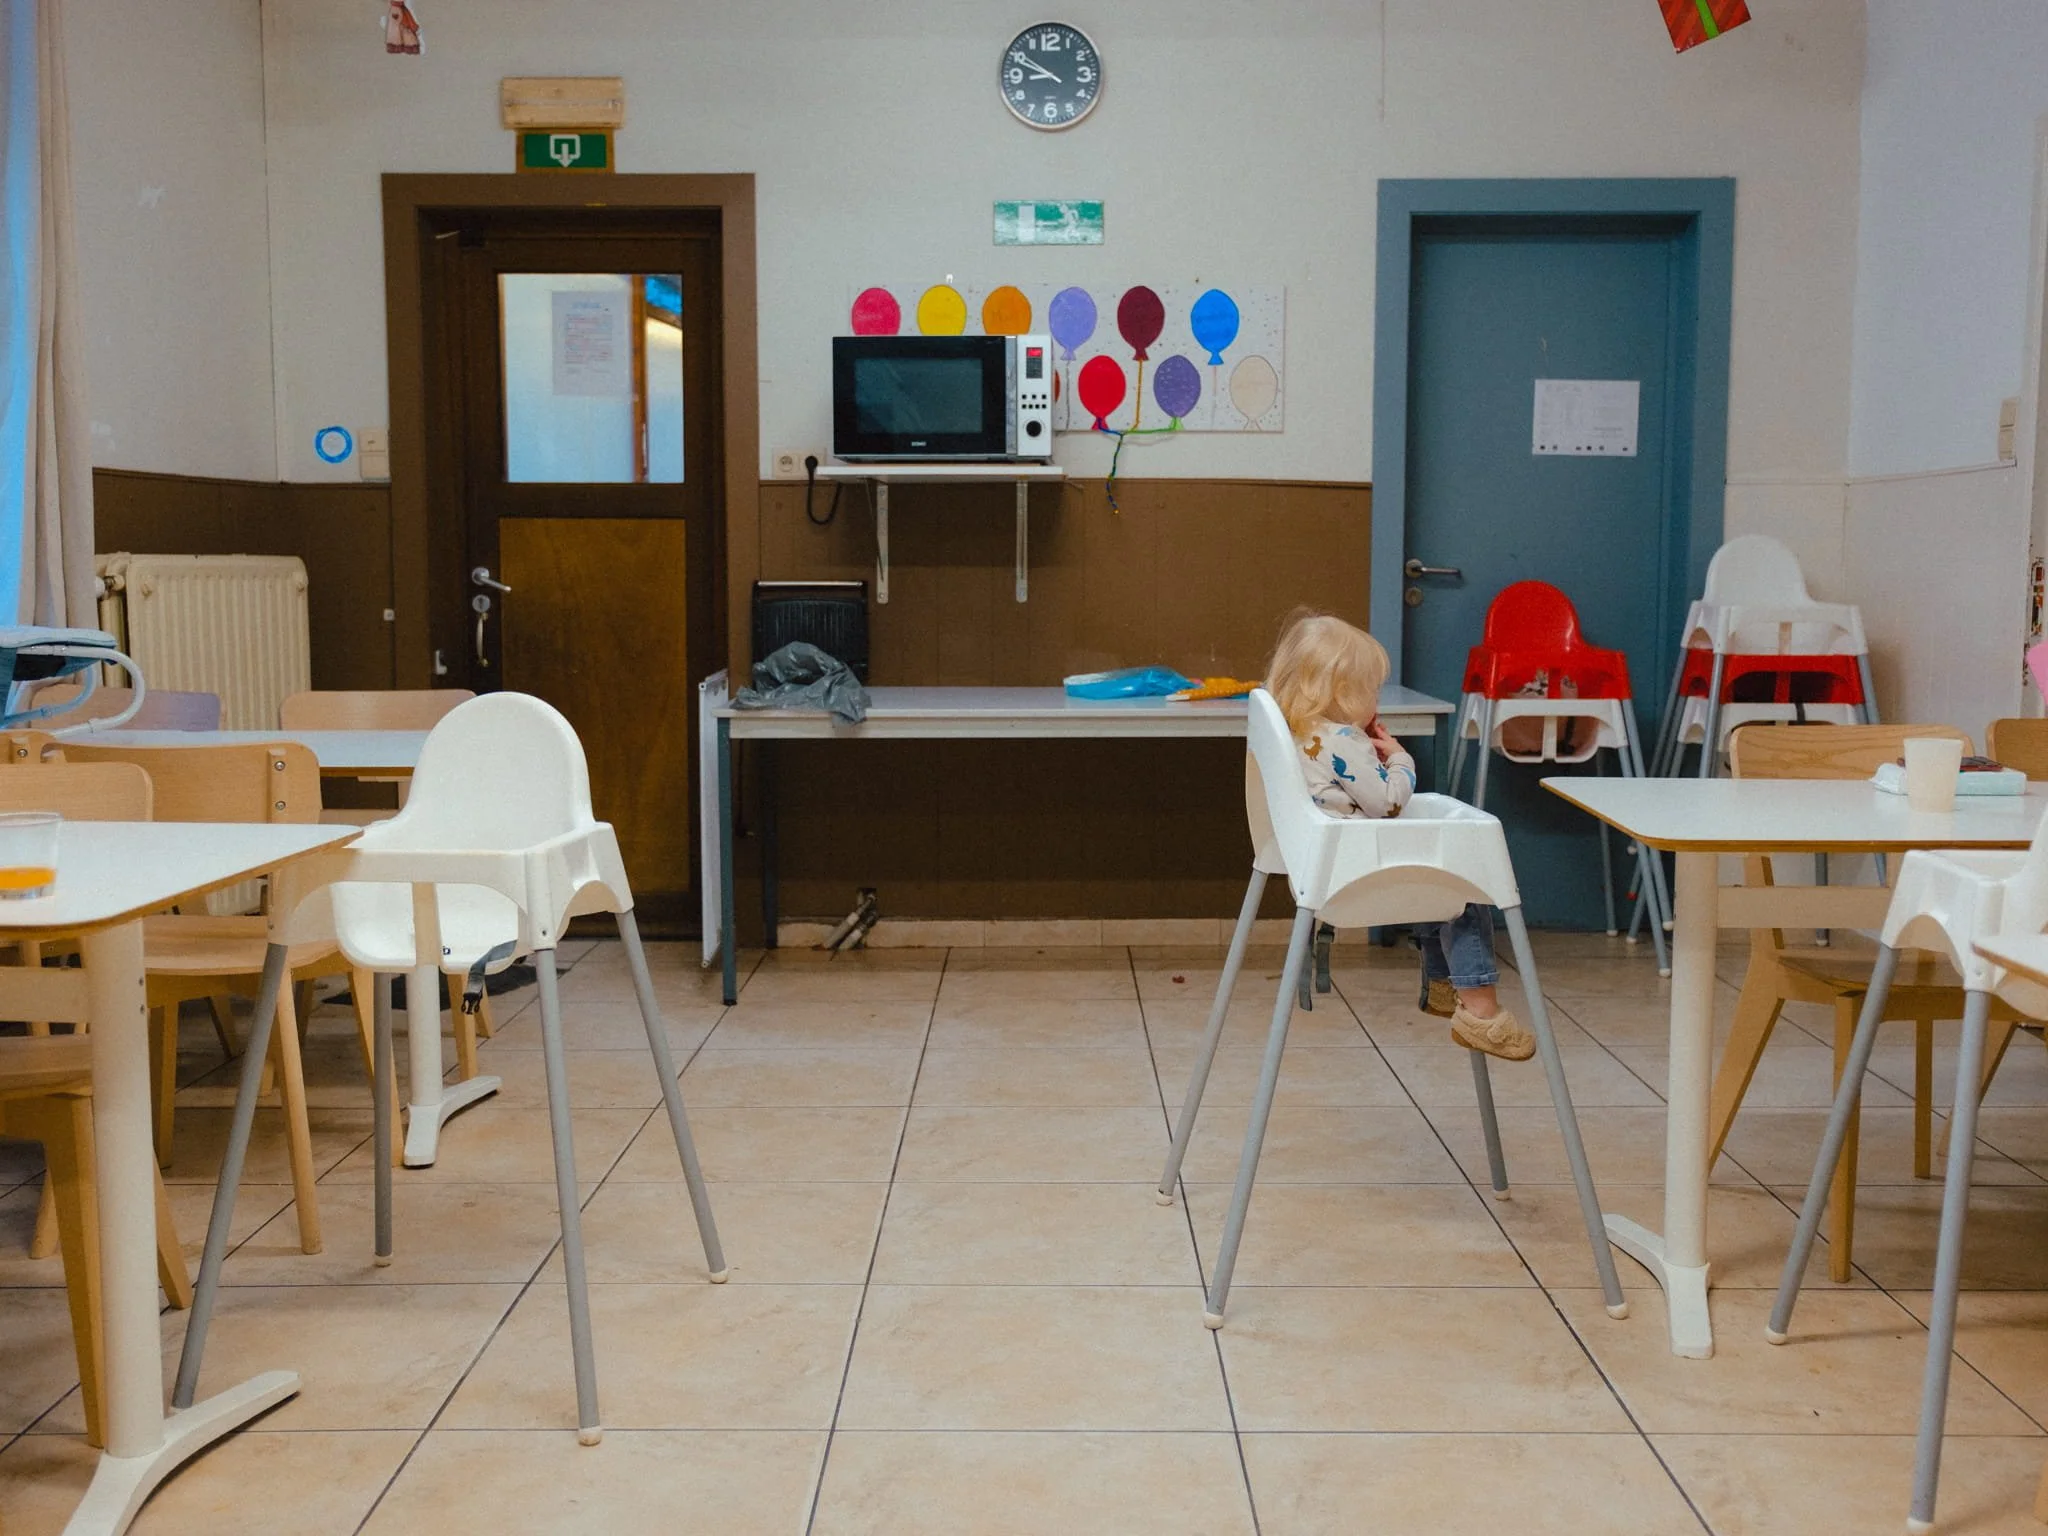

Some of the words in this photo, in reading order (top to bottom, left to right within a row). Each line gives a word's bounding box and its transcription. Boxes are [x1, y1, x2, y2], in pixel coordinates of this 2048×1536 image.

[1029, 38, 1036, 50] 11
[1041, 33, 1061, 52] 12
[1066, 37, 1070, 49] 1
[1076, 50, 1086, 61] 2
[1010, 67, 1023, 84] 9
[1076, 66, 1091, 83] 3
[1015, 90, 1025, 101] 8
[1076, 89, 1086, 98] 4
[1027, 104, 1036, 116] 7
[1044, 102, 1058, 118] 6
[1065, 103, 1074, 113] 5
